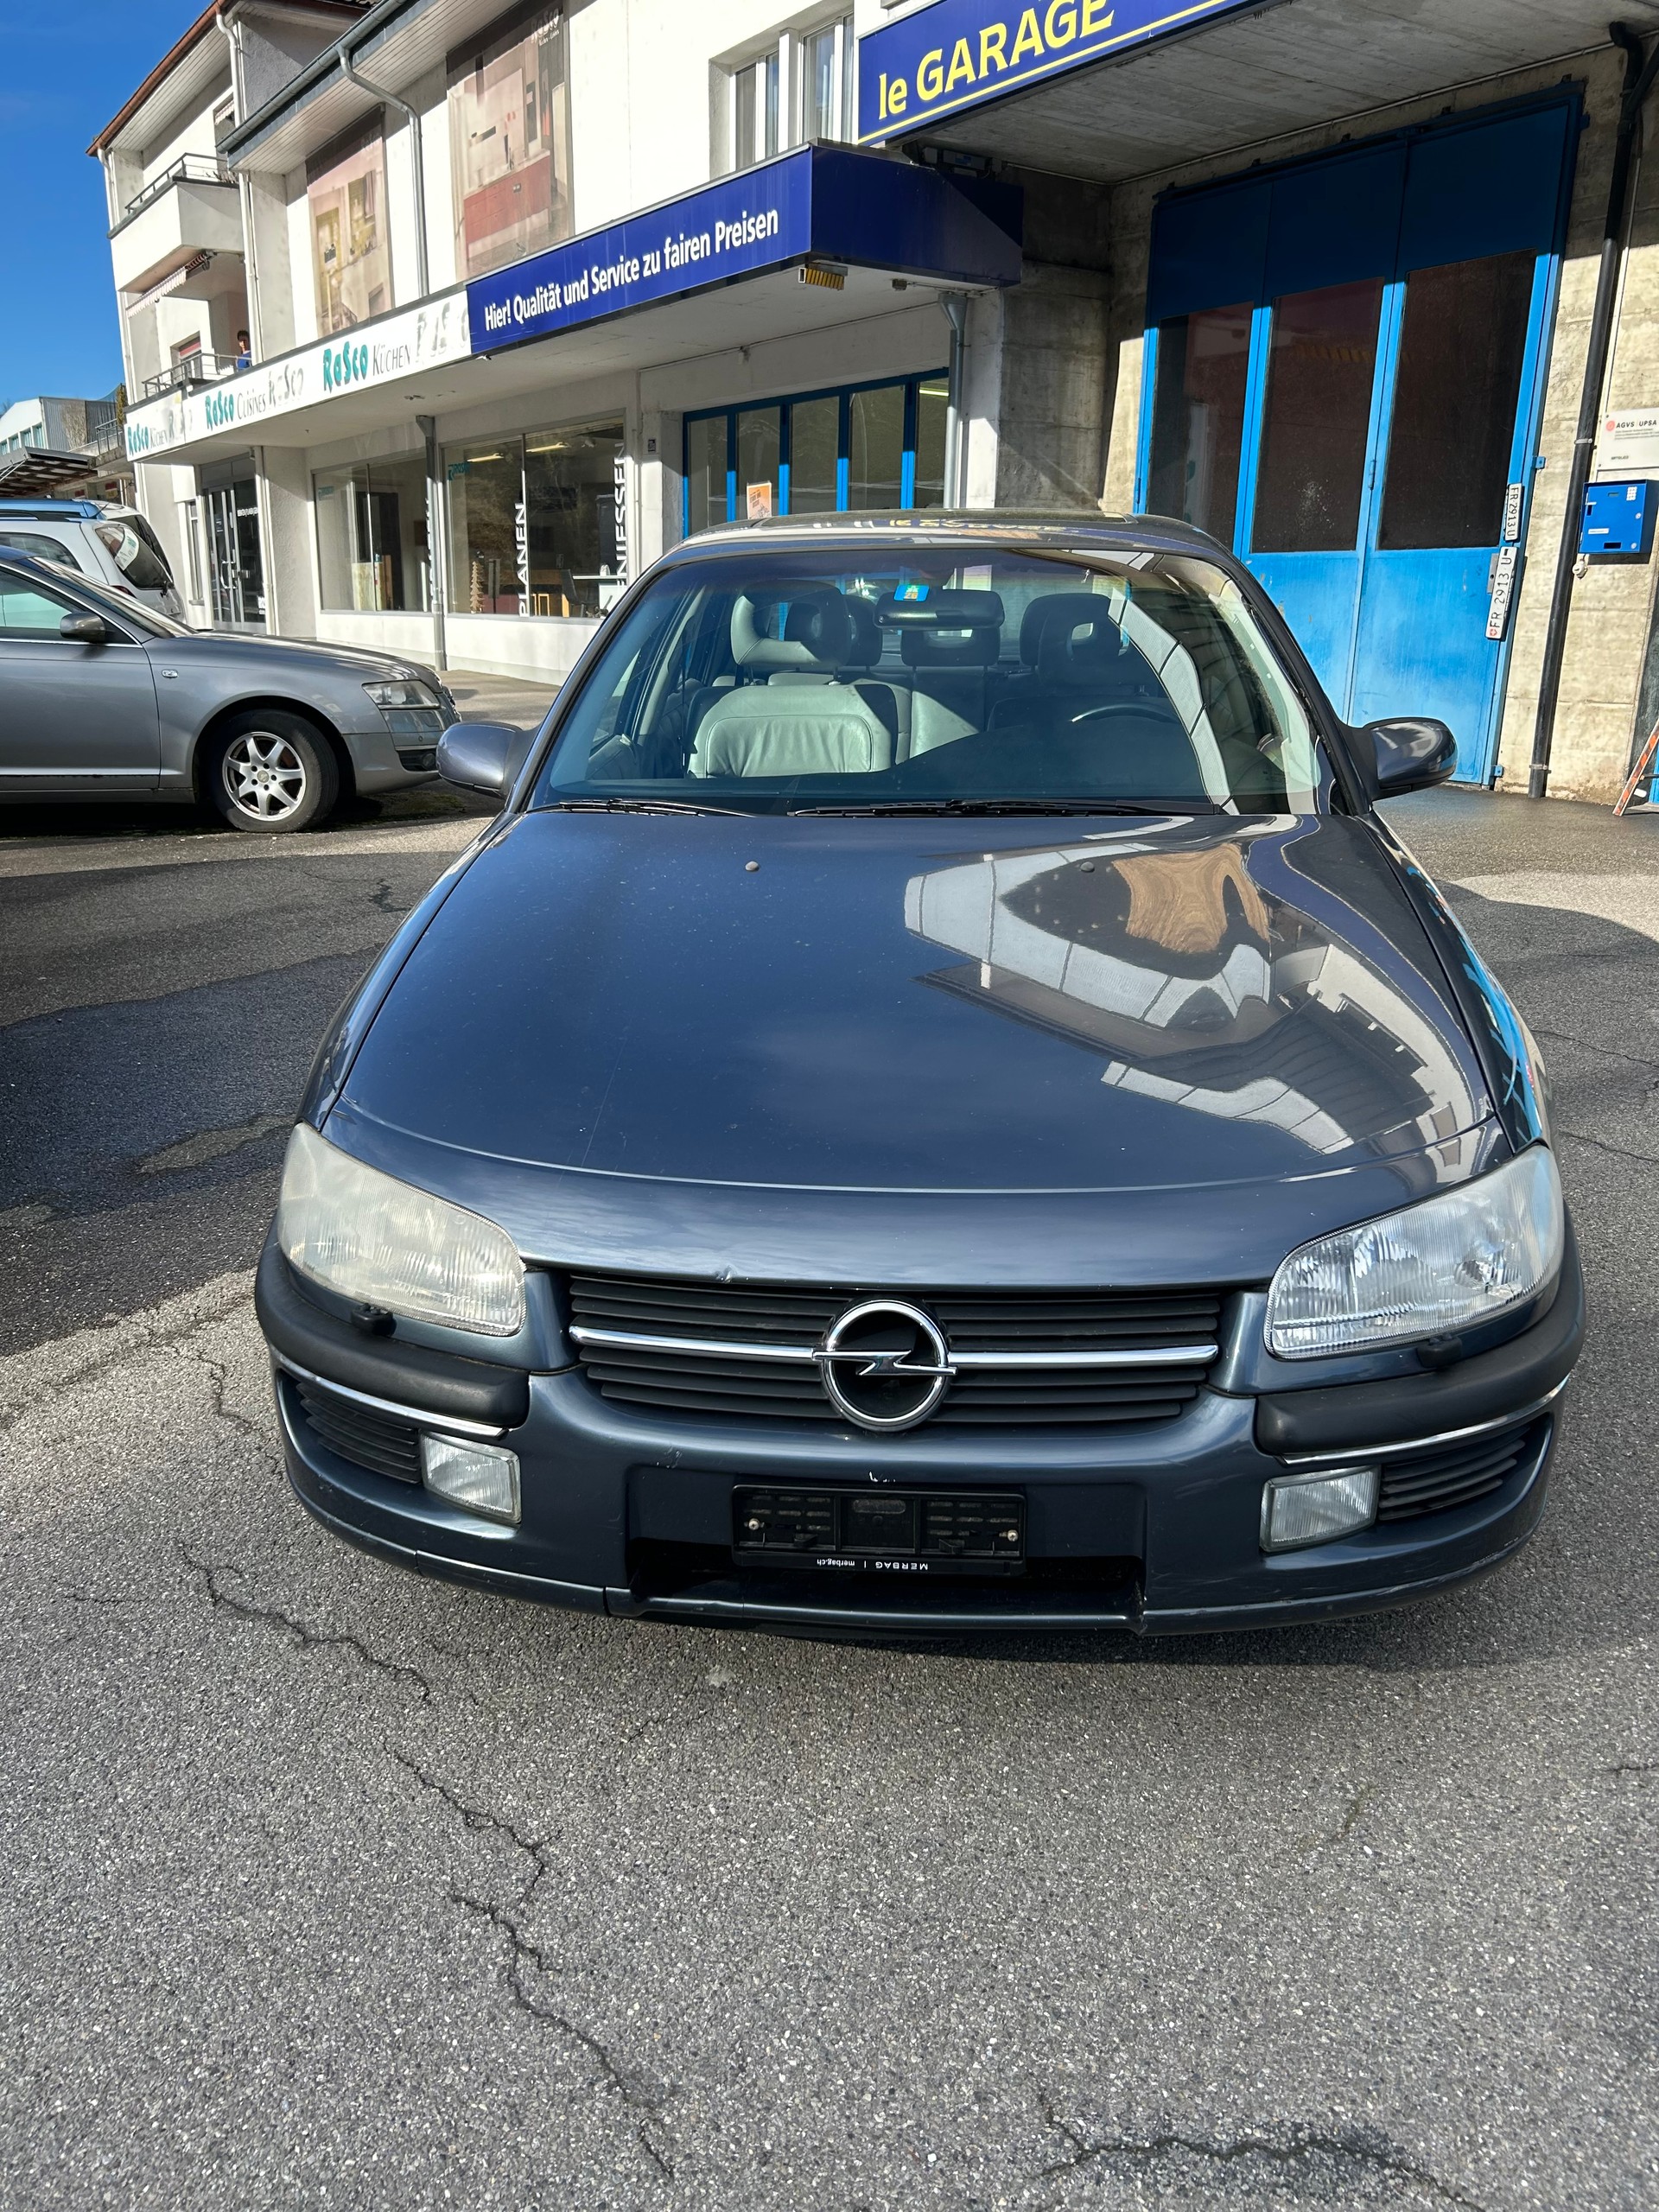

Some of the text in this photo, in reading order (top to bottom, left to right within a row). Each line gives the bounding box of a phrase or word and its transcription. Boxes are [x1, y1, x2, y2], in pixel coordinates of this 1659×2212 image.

[879, 0, 1115, 119] le GARAGE
[485, 209, 779, 331] Hier! Qualität und Service zu fairen Preisen
[515, 503, 529, 617] PLANEN
[1494, 573, 1510, 605] 2913
[1489, 612, 1501, 629] FR
[817, 1558, 929, 1571] MERBAG merbag.ch
